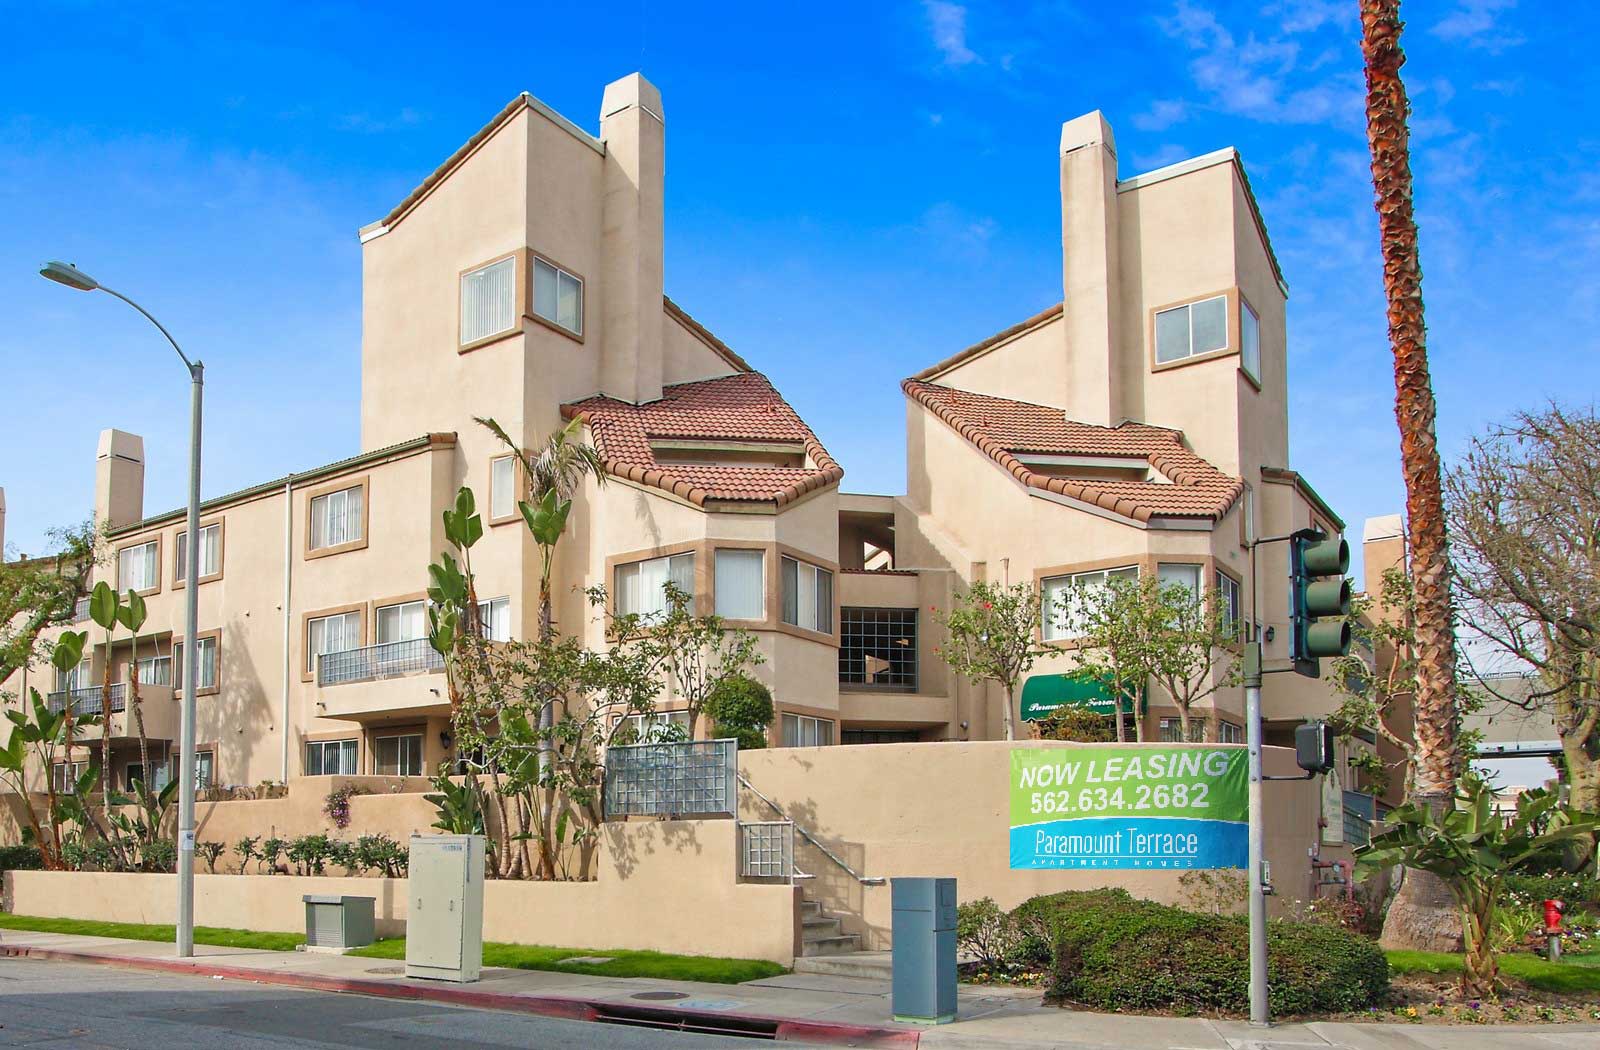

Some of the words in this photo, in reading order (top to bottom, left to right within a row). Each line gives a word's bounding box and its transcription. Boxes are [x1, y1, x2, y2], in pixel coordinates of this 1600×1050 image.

[1019, 761, 1081, 789] NOW
[1086, 751, 1230, 783] LEASING
[1030, 783, 1210, 814] 562.634.2682
[1035, 829, 1123, 854] Paramount
[1126, 827, 1198, 854] Terrace
